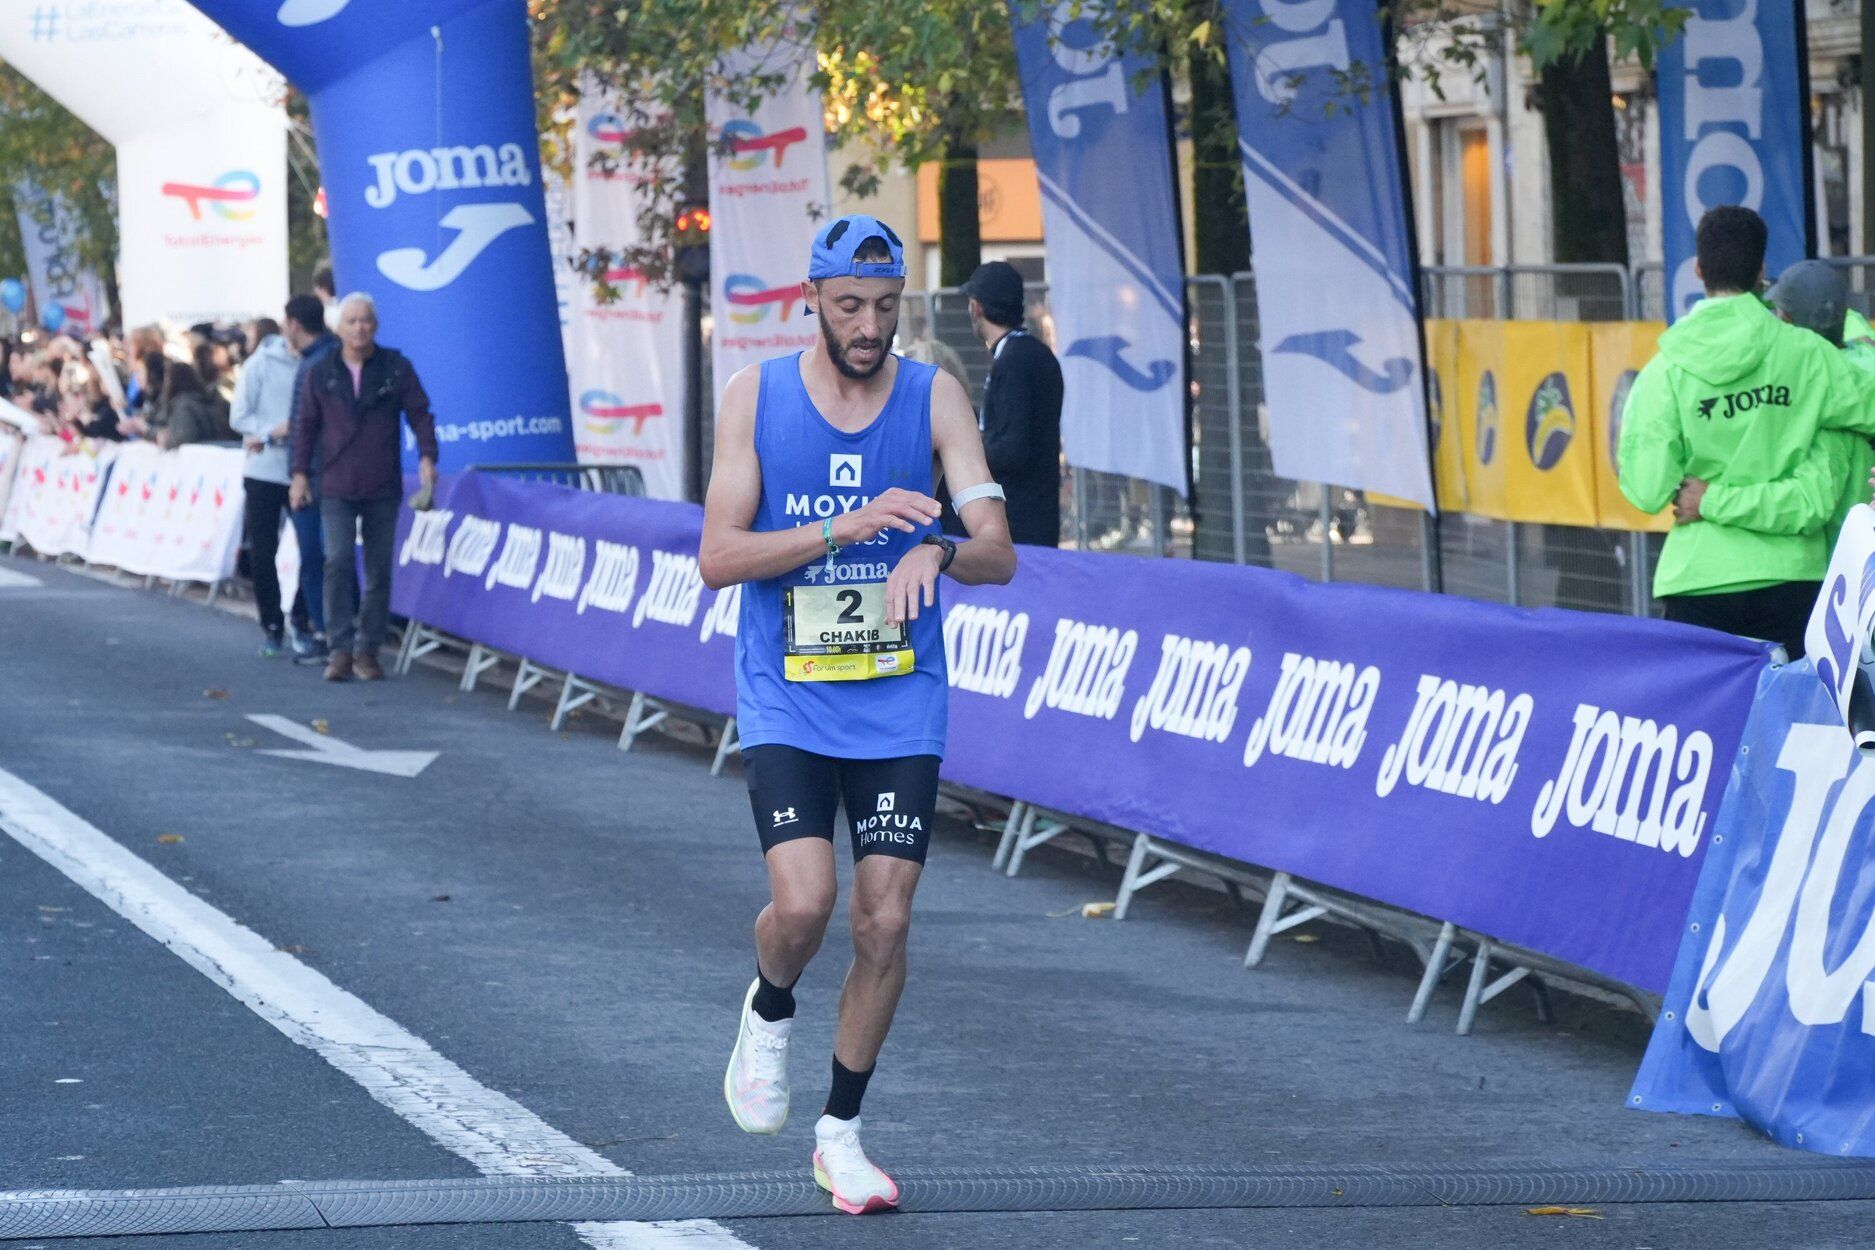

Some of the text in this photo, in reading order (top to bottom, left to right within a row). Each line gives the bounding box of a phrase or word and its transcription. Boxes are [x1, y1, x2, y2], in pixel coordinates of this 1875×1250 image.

[836, 589, 864, 624] 2
[819, 629, 880, 643] CHAKIB
[856, 814, 922, 834] MOYUA
[860, 830, 915, 847] Homes
